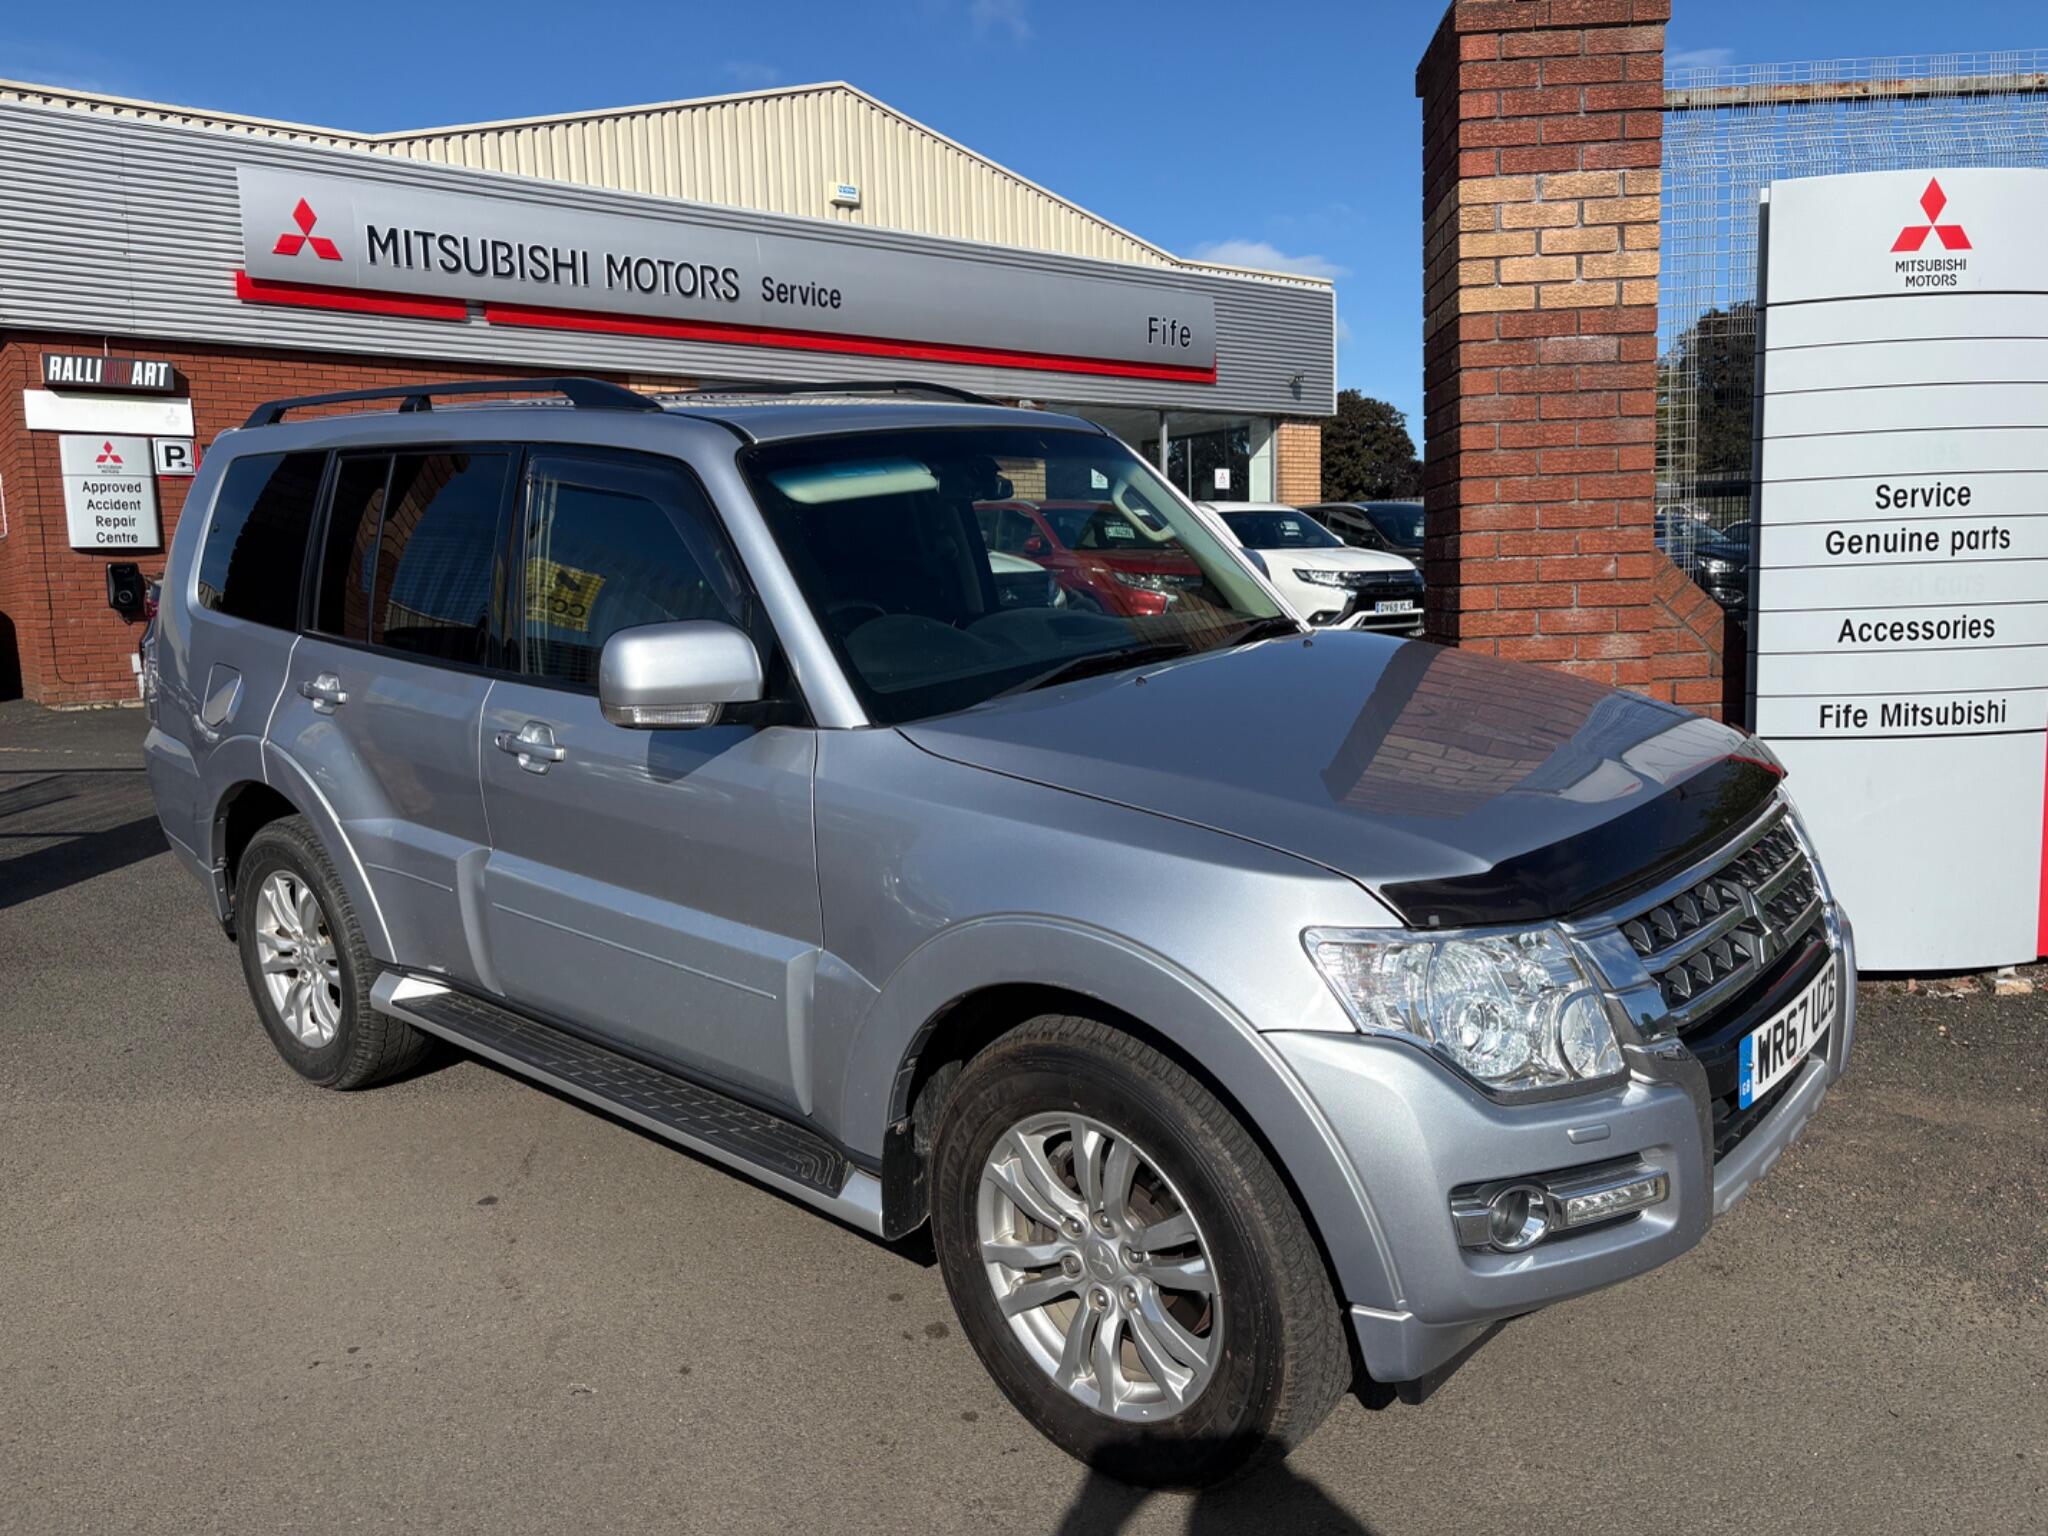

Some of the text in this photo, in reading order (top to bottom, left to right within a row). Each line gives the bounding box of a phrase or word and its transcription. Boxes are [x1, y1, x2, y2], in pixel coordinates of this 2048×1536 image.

[366, 224, 842, 310] MITSUBISHI MOTORS Service
[1895, 258, 1968, 273] MITSUBISHI
[1905, 274, 1958, 288] MOTORS
[1147, 316, 1192, 349] Fife
[164, 444, 186, 468] P
[82, 480, 143, 495] Approved
[1875, 482, 1972, 510] Service
[86, 499, 142, 511] Accident
[95, 515, 136, 529] Repair
[96, 531, 139, 544] Centre
[1825, 525, 2011, 557] Genuine parts
[1837, 614, 1996, 644] Accessories
[1819, 698, 2007, 729] Fife Mitsubishi
[1757, 999, 1808, 1085] WR67
